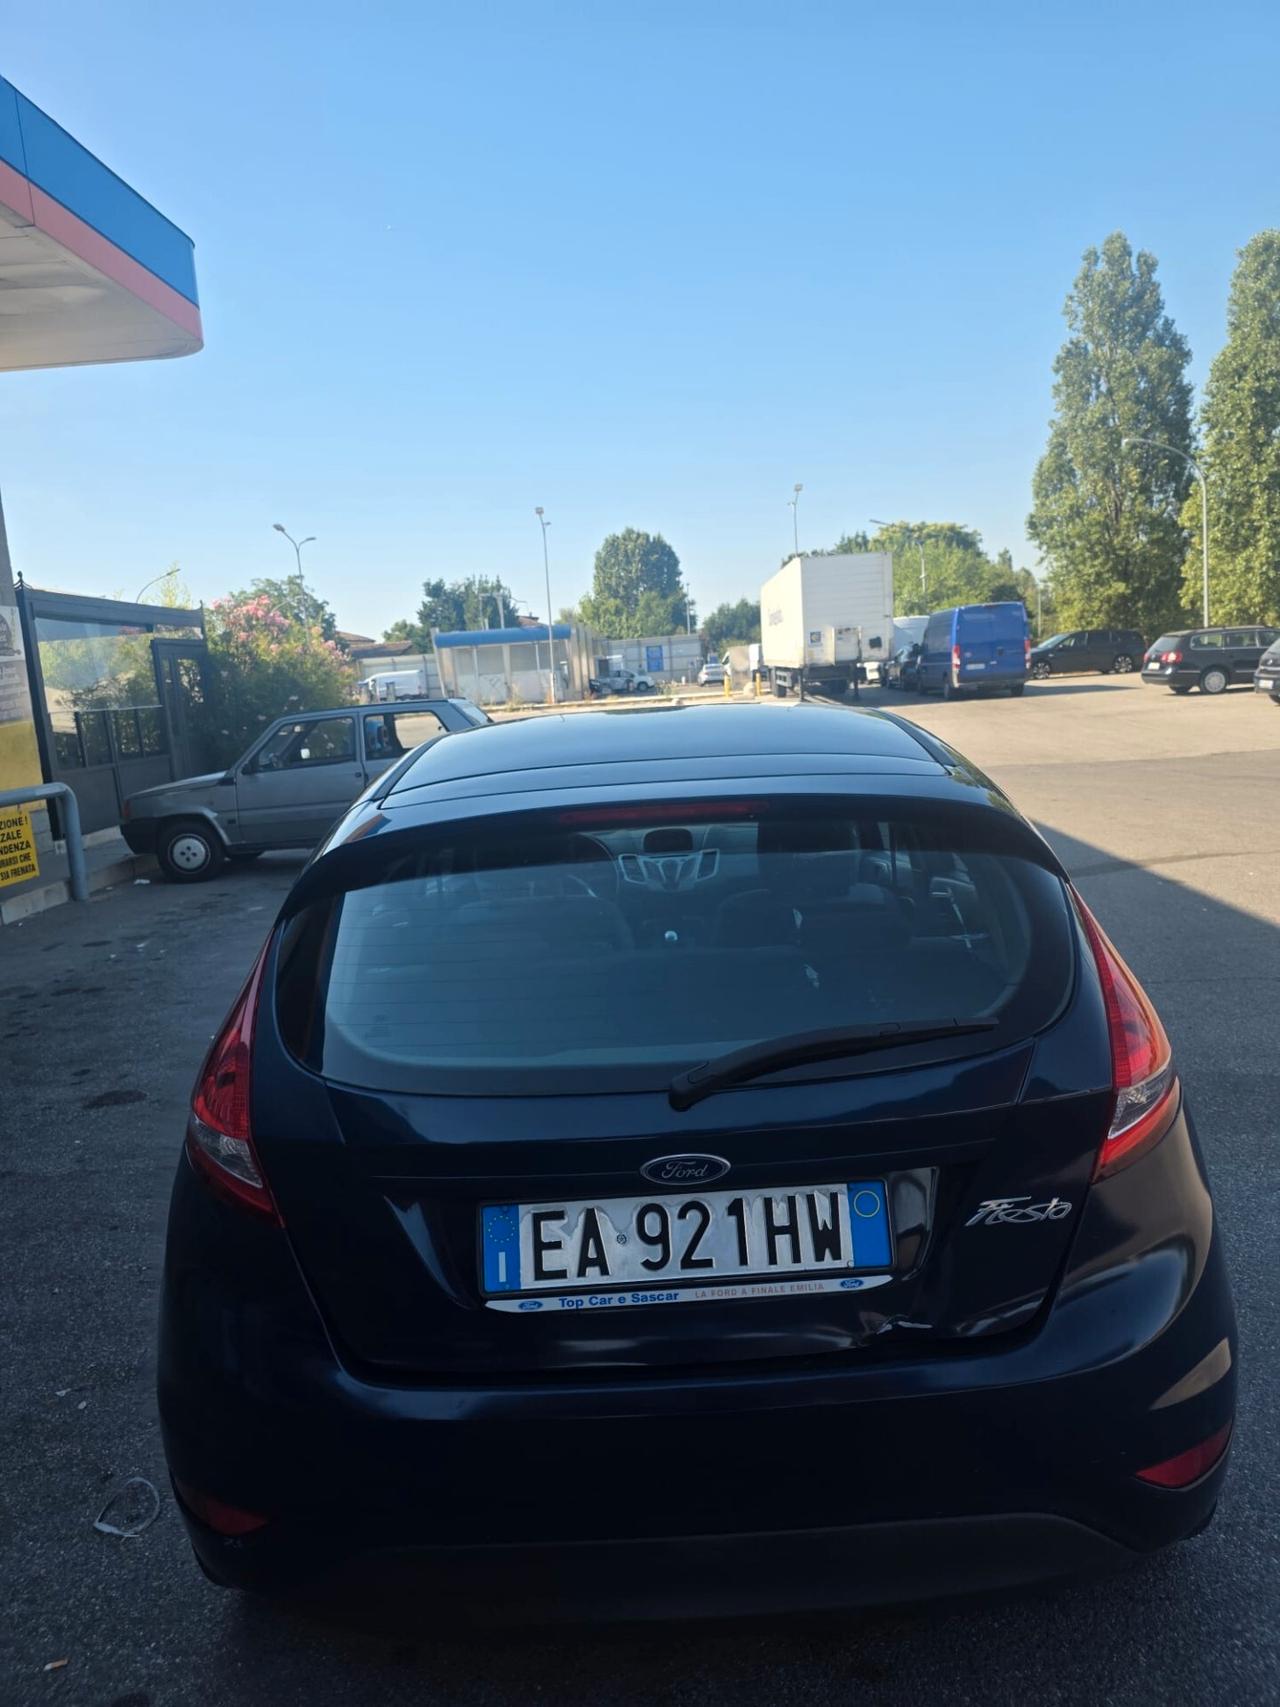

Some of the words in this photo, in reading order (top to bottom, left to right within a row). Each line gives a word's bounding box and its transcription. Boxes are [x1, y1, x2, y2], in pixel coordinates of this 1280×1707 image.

[661, 1161, 708, 1178] Ford
[965, 1196, 1072, 1226] Fiesta
[695, 1290, 707, 1298] LA
[711, 1288, 737, 1297] FORD
[741, 1288, 748, 1296] A
[751, 1285, 785, 1295] FINALE
[790, 1283, 825, 1293] EMILIA
[559, 1298, 584, 1310] Top
[588, 1296, 613, 1306] Car
[617, 1296, 626, 1304] e
[631, 1292, 680, 1304] Sascar
